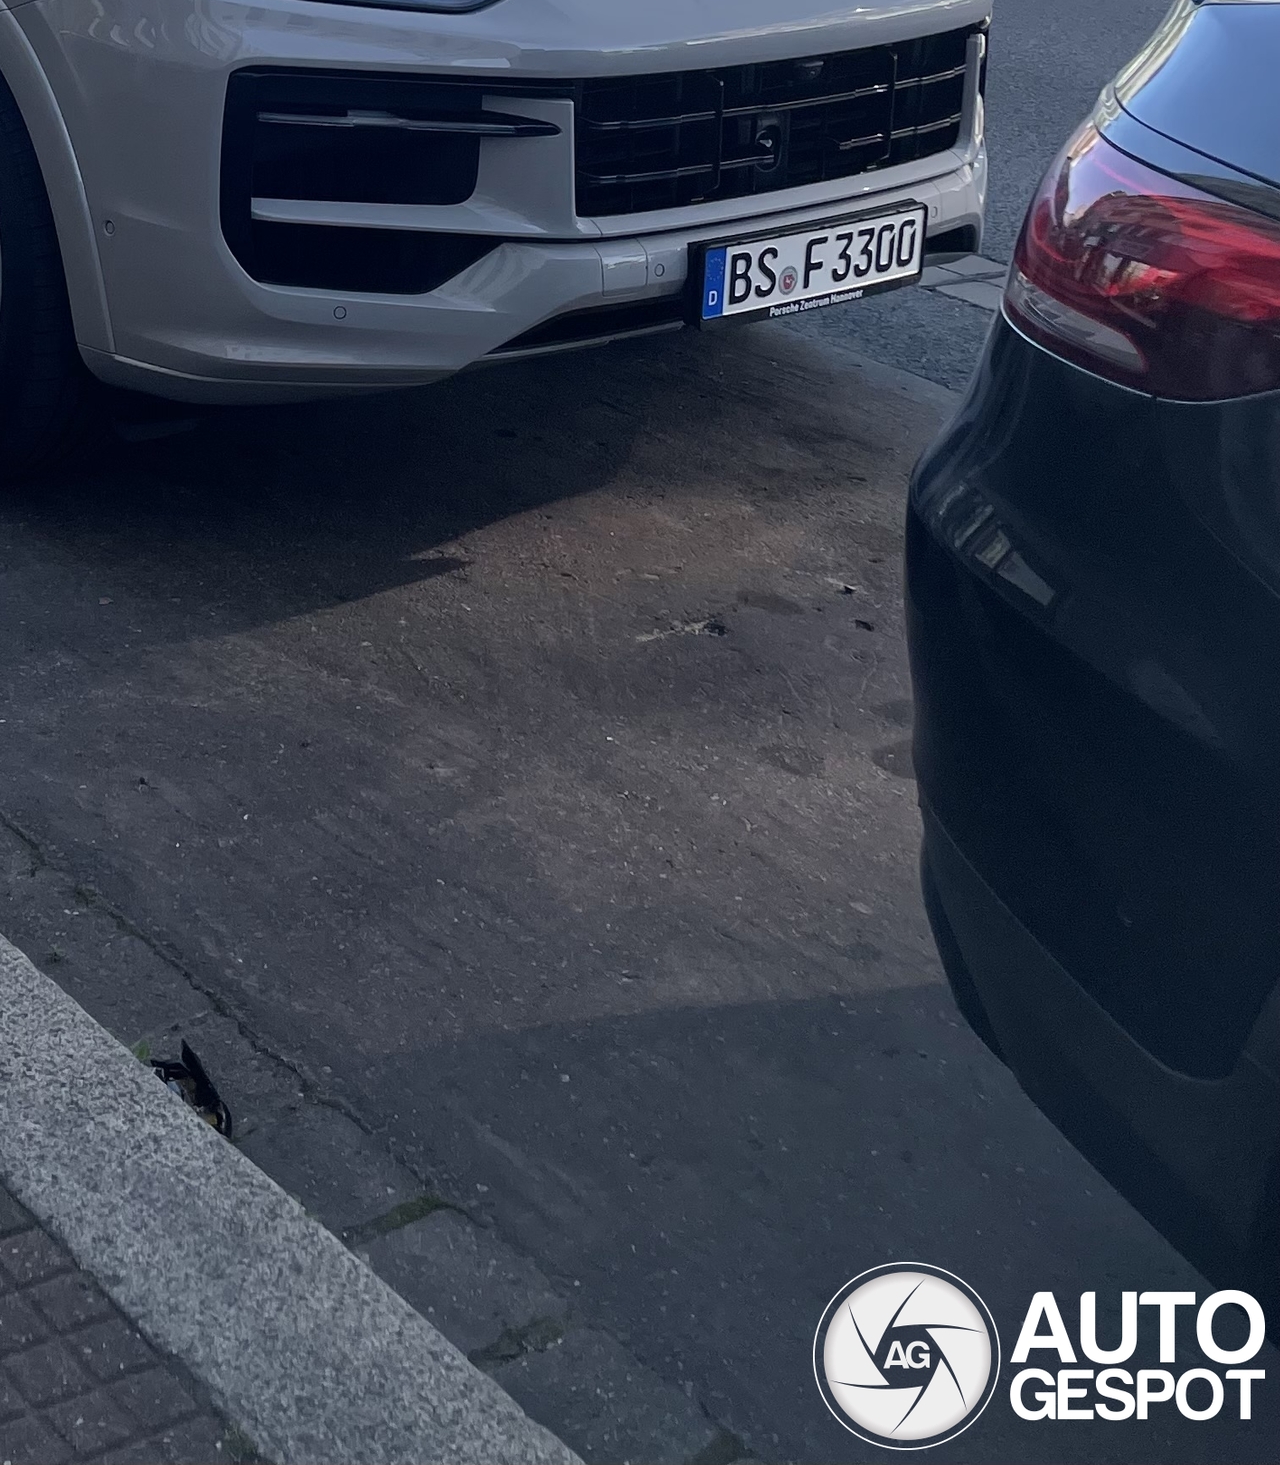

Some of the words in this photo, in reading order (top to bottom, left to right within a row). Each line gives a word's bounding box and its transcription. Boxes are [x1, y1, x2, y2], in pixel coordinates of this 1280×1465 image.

[730, 247, 778, 305] BS
[708, 291, 718, 306] D
[769, 303, 799, 317] Porsche
[800, 296, 830, 311] Zentrum
[830, 289, 864, 304] Hannover
